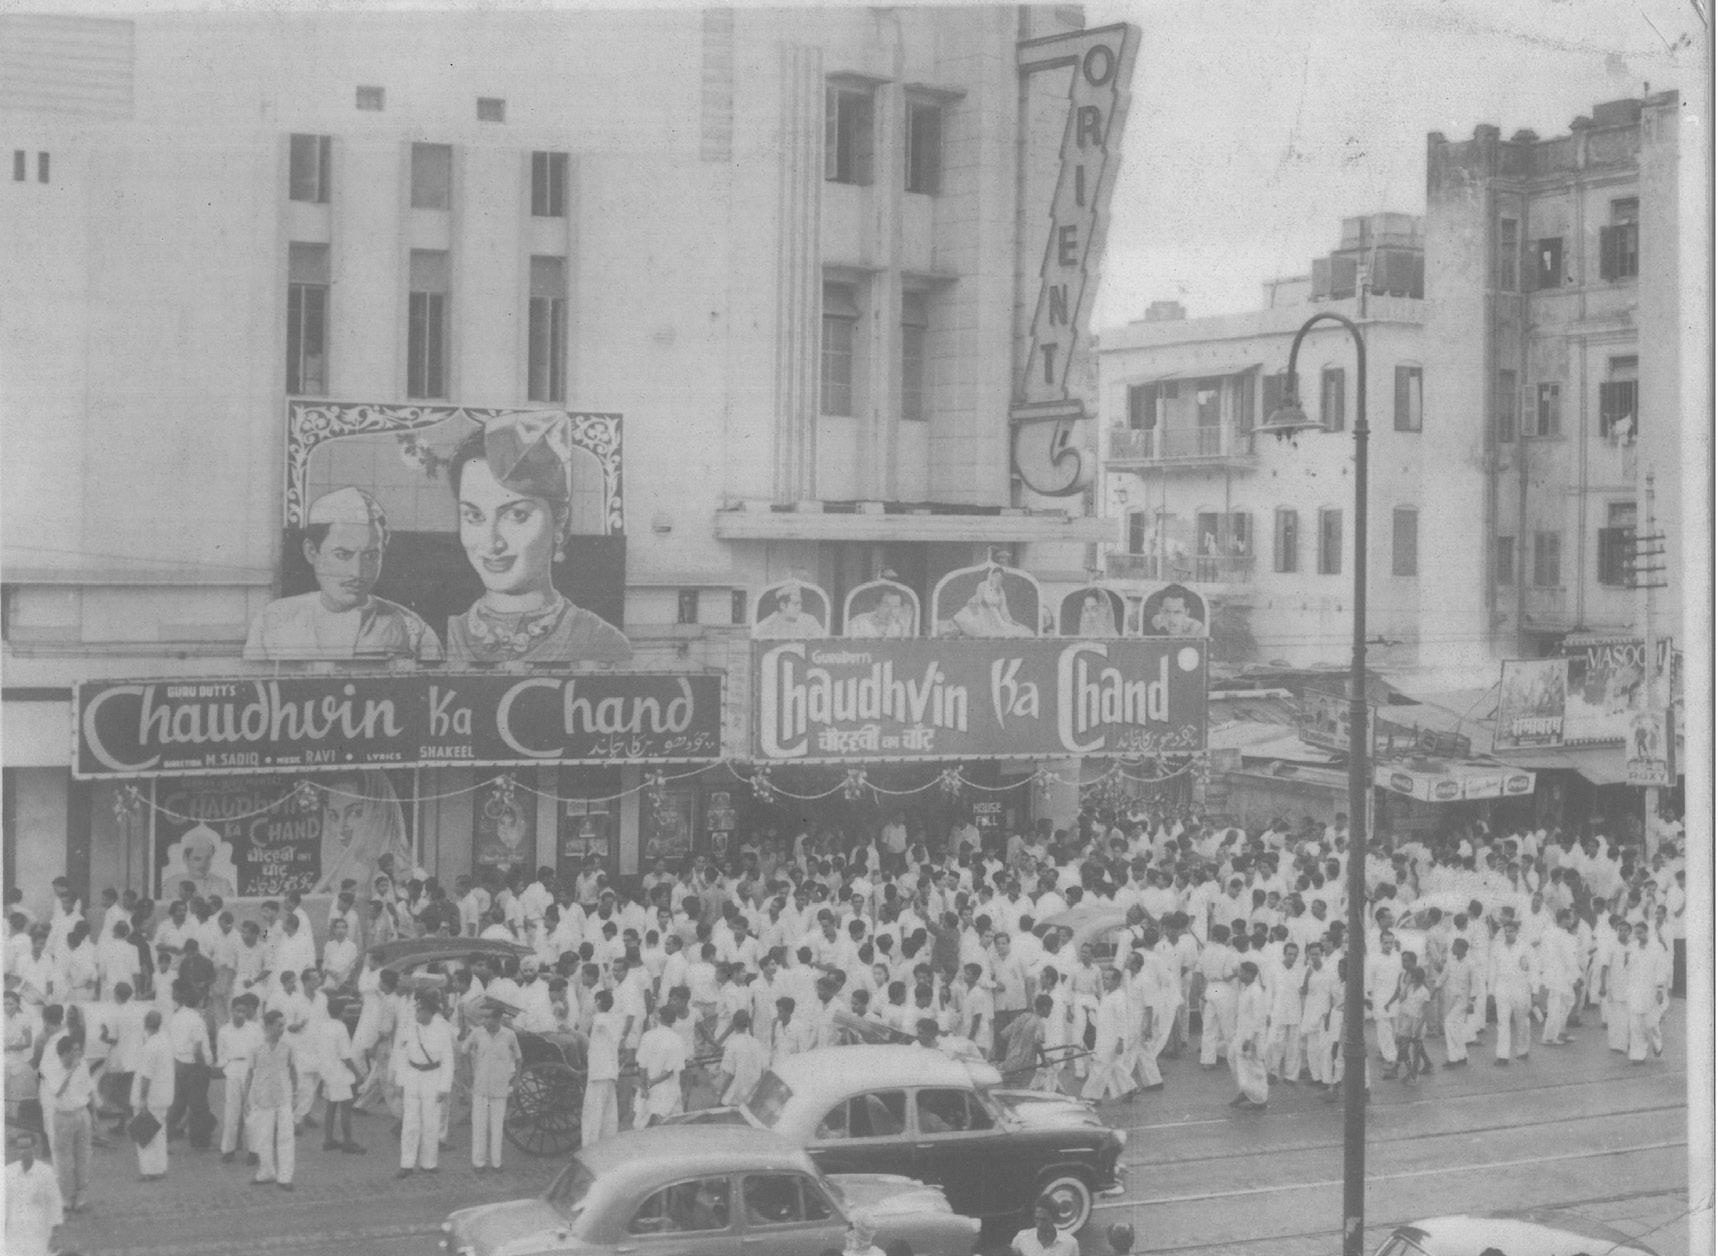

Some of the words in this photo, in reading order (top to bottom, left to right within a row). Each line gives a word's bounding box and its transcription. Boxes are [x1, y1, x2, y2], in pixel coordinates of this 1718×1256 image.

[1040, 44, 1115, 385] ORIENT
[1585, 645, 1664, 669] MASOO
[167, 686, 196, 698] GURU
[199, 684, 237, 697] DUTT'S
[761, 643, 968, 758] Chaudhvin
[991, 657, 1039, 730] Ka
[1058, 642, 1169, 753] Chand
[83, 680, 404, 771] Chaudhvin
[429, 685, 472, 737] Ka
[496, 676, 694, 758] Chand
[305, 749, 337, 764] RAVI
[366, 752, 402, 762] LYRICS
[419, 744, 475, 758] SHAKEEL
[249, 817, 321, 848] CHAND
